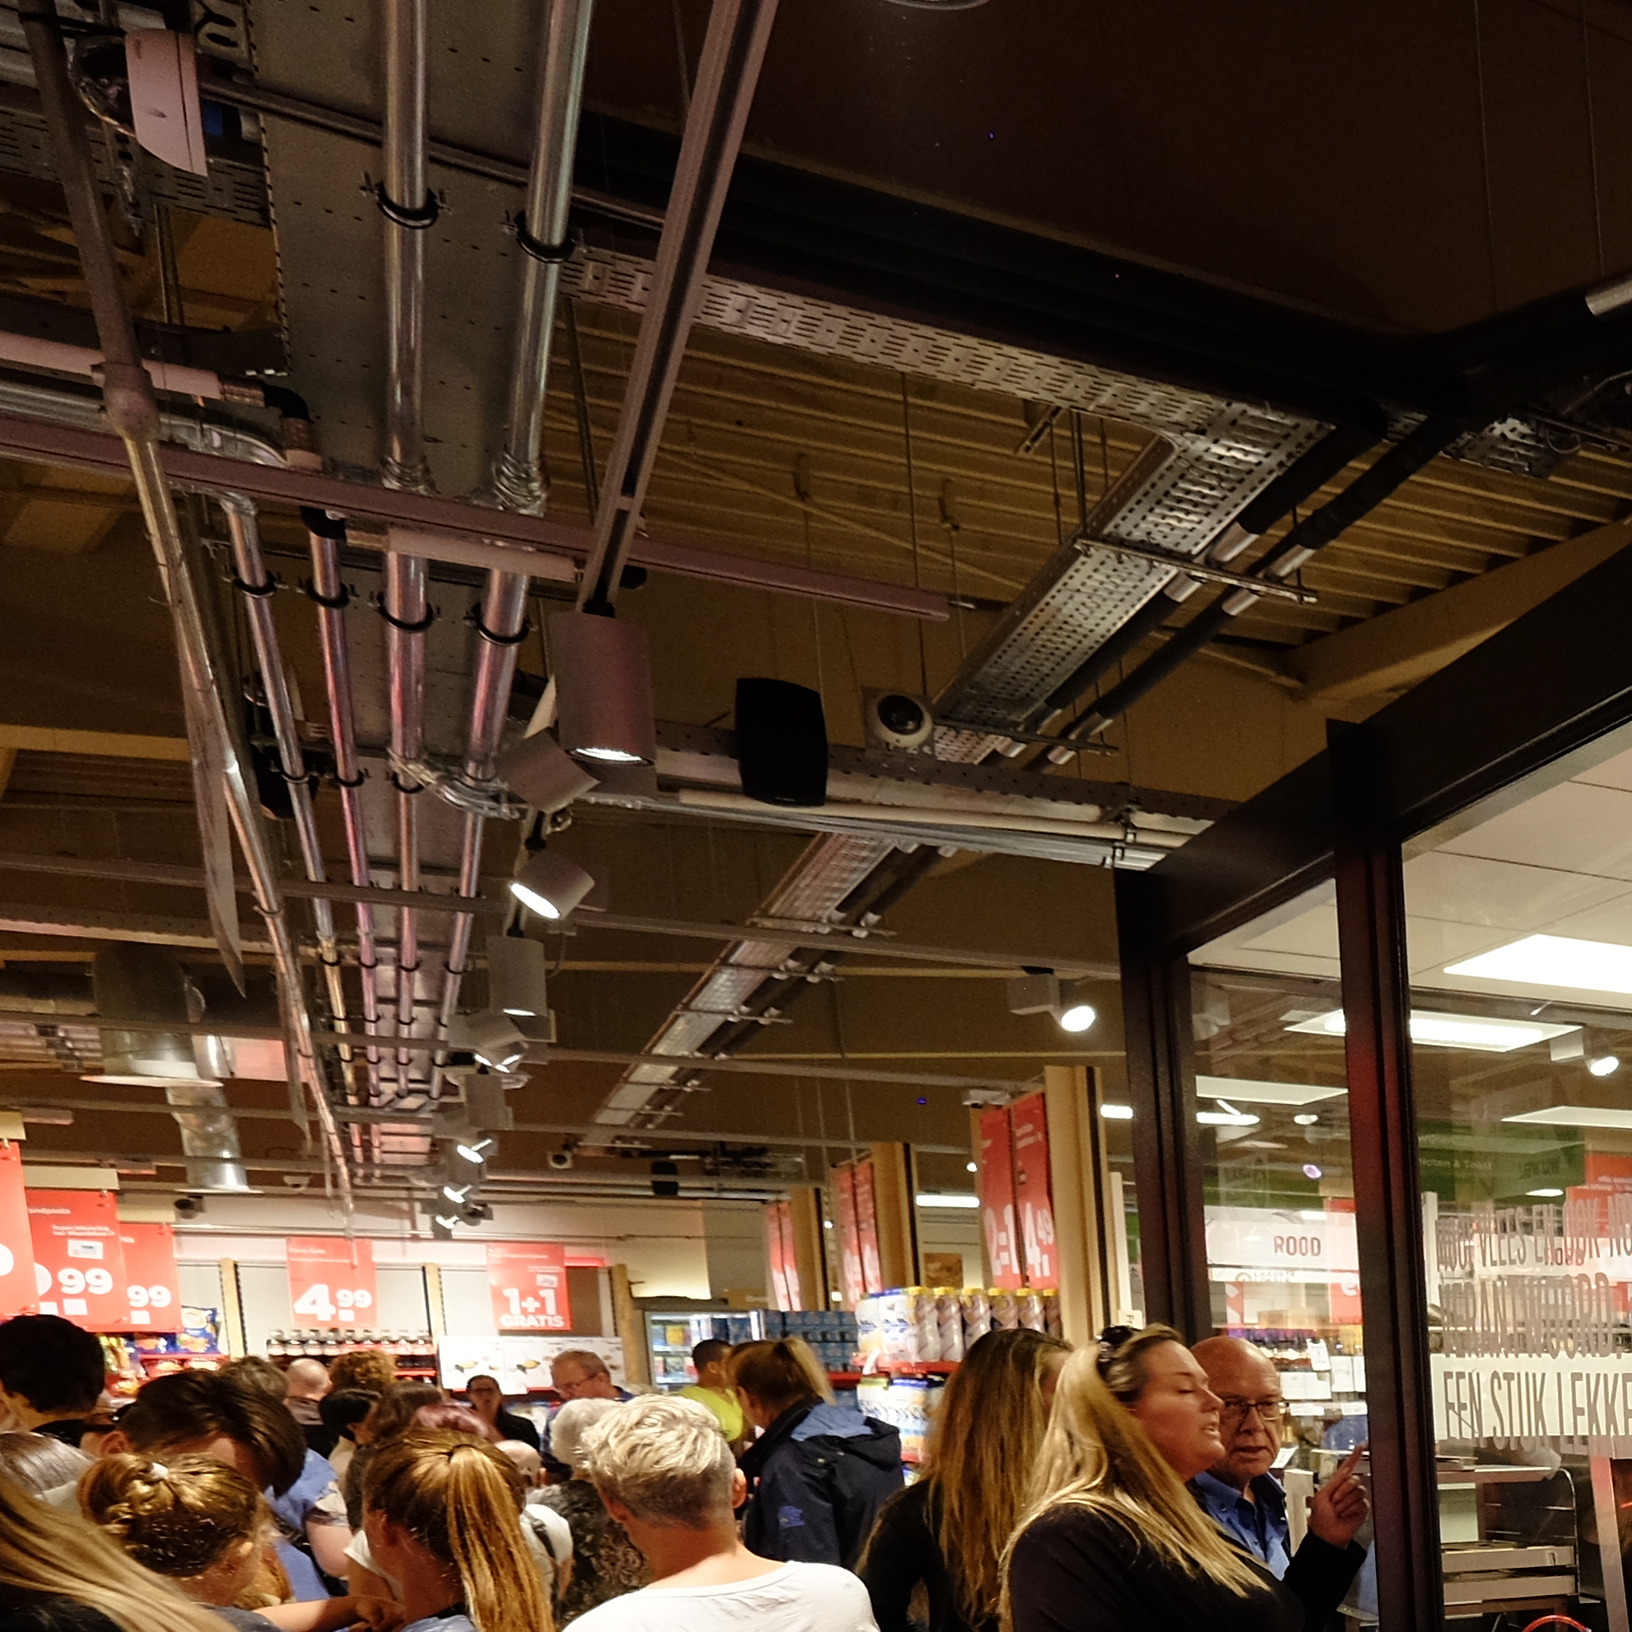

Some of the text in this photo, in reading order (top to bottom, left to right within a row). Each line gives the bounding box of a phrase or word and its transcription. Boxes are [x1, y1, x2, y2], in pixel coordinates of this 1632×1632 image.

[1273, 1235, 1322, 1257] ROOD
[502, 1287, 557, 1316] 1+1
[499, 1314, 564, 1328] GRATIS
[1442, 1370, 1485, 1445] EEN
[1489, 1369, 1551, 1449] STUK
